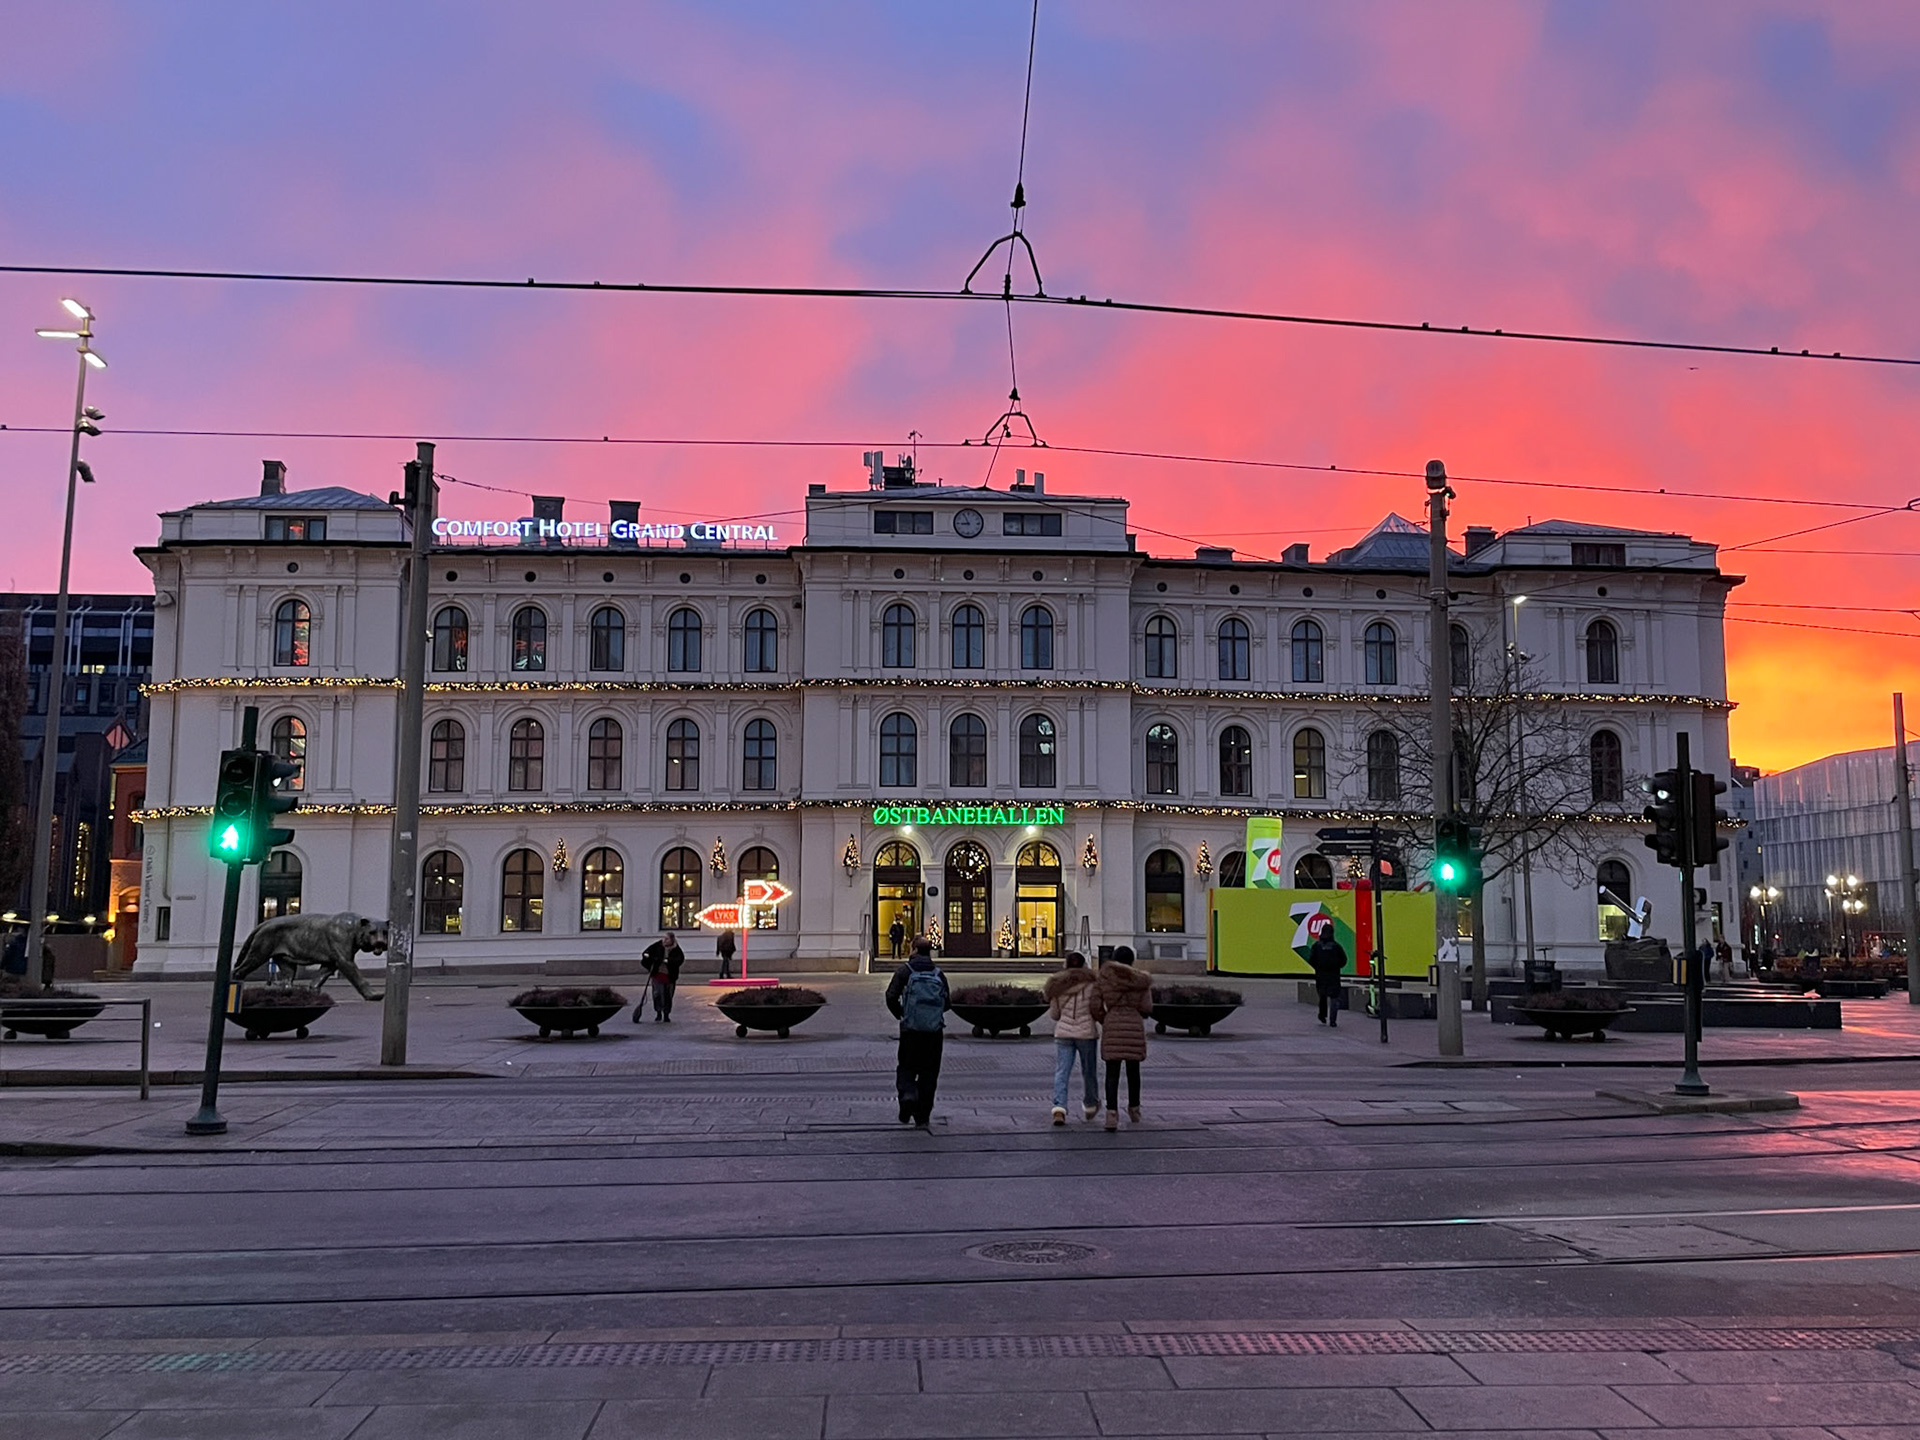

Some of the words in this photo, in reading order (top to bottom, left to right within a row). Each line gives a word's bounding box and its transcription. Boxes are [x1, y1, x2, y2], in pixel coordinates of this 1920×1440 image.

[431, 516, 534, 538] COMFORT
[539, 519, 603, 538] HOTEL
[611, 519, 684, 539] GRAND
[690, 522, 779, 540] CENTRAL
[873, 807, 1065, 825] ØSTBANEHALLEN
